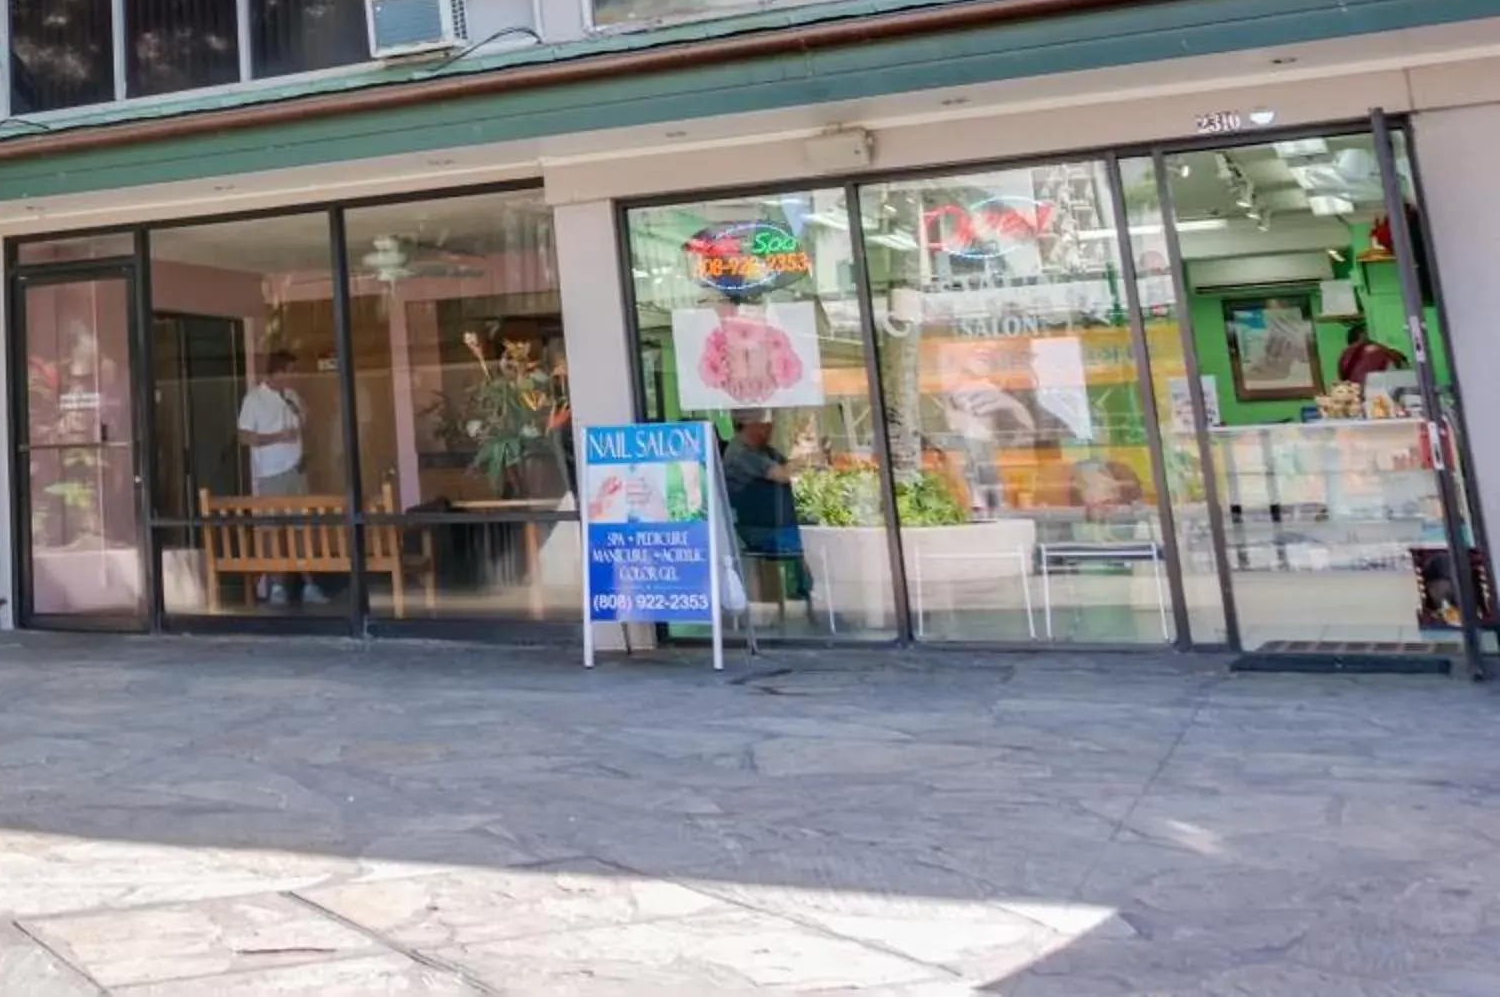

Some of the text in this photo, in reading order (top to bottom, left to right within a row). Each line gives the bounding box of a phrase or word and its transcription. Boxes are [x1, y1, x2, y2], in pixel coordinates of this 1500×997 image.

[1194, 110, 1241, 132] 2310
[752, 231, 798, 255] Spa
[588, 427, 701, 460] NAIL SALON
[593, 591, 709, 613] (808) 922-2353
